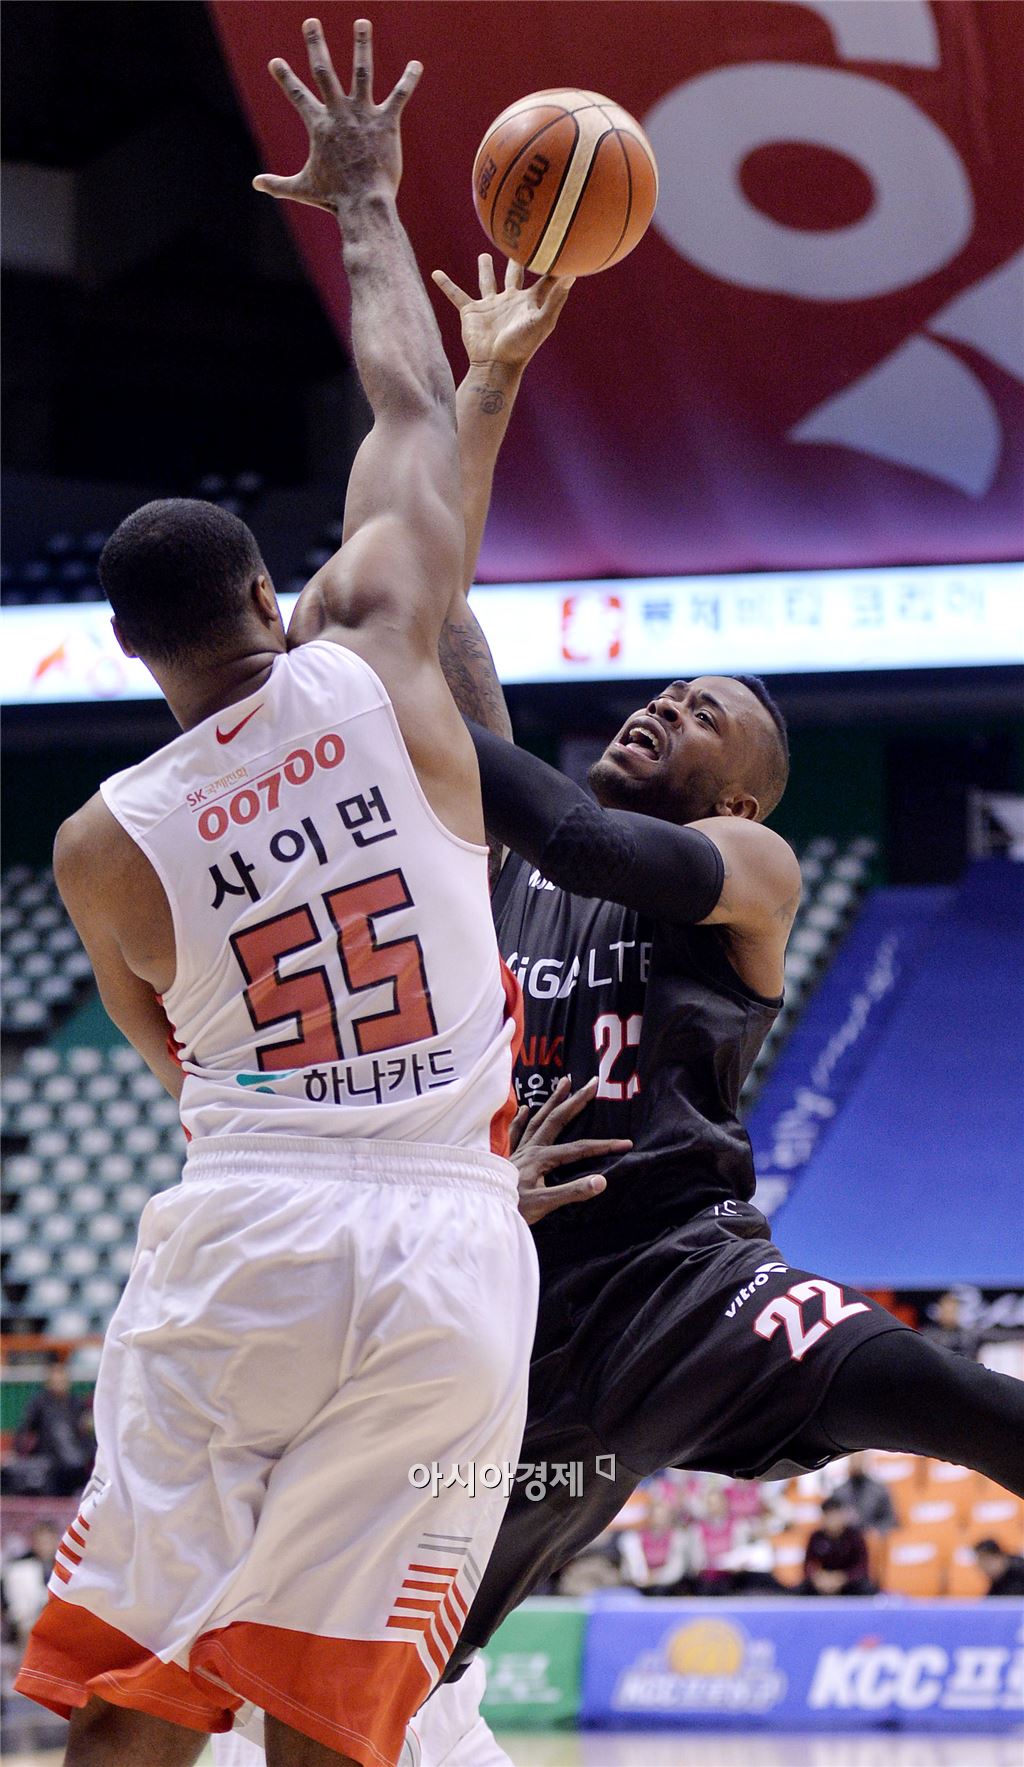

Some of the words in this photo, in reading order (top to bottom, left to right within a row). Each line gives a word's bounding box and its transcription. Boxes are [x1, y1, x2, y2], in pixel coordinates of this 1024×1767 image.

[503, 153, 549, 249] molten
[198, 733, 346, 842] 00700
[208, 785, 398, 910] 사이먼
[229, 867, 438, 1073] 55
[303, 1049, 460, 1105] 하나카드
[724, 1273, 770, 1319] vitro
[752, 1279, 873, 1362] 22
